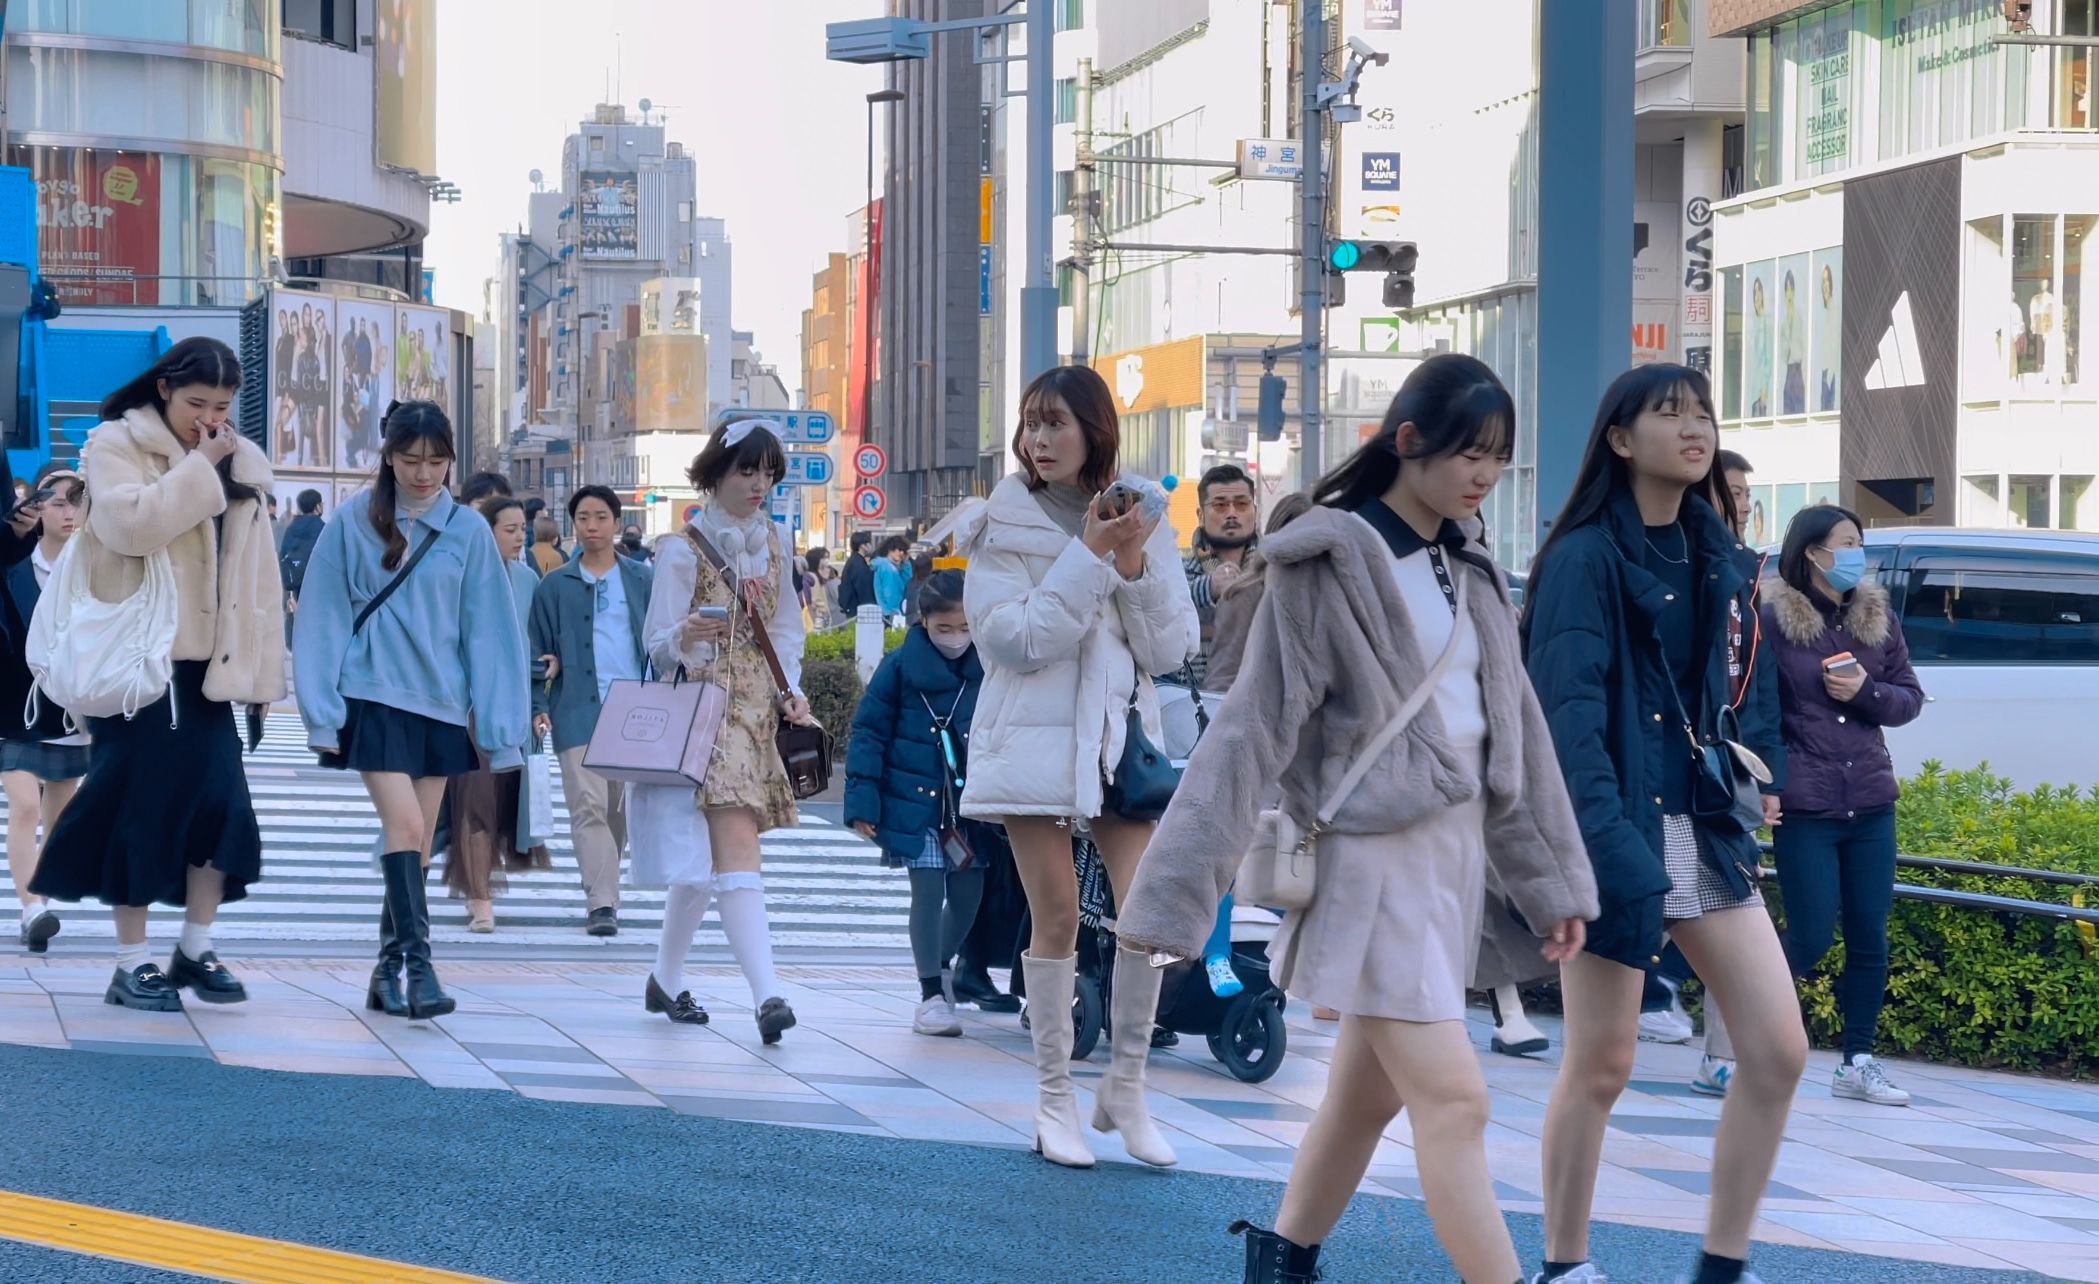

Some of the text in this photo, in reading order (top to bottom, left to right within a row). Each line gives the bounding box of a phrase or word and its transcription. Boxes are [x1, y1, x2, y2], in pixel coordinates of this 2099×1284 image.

[1367, 107, 1395, 121] くら
[1371, 159, 1390, 171] YM
[72, 251, 100, 261] BASED
[597, 247, 635, 257] Nautilus
[1685, 227, 1713, 293] くら
[1686, 296, 1711, 322] 寿司
[277, 370, 329, 392] GUCCI
[860, 453, 879, 469] 50
